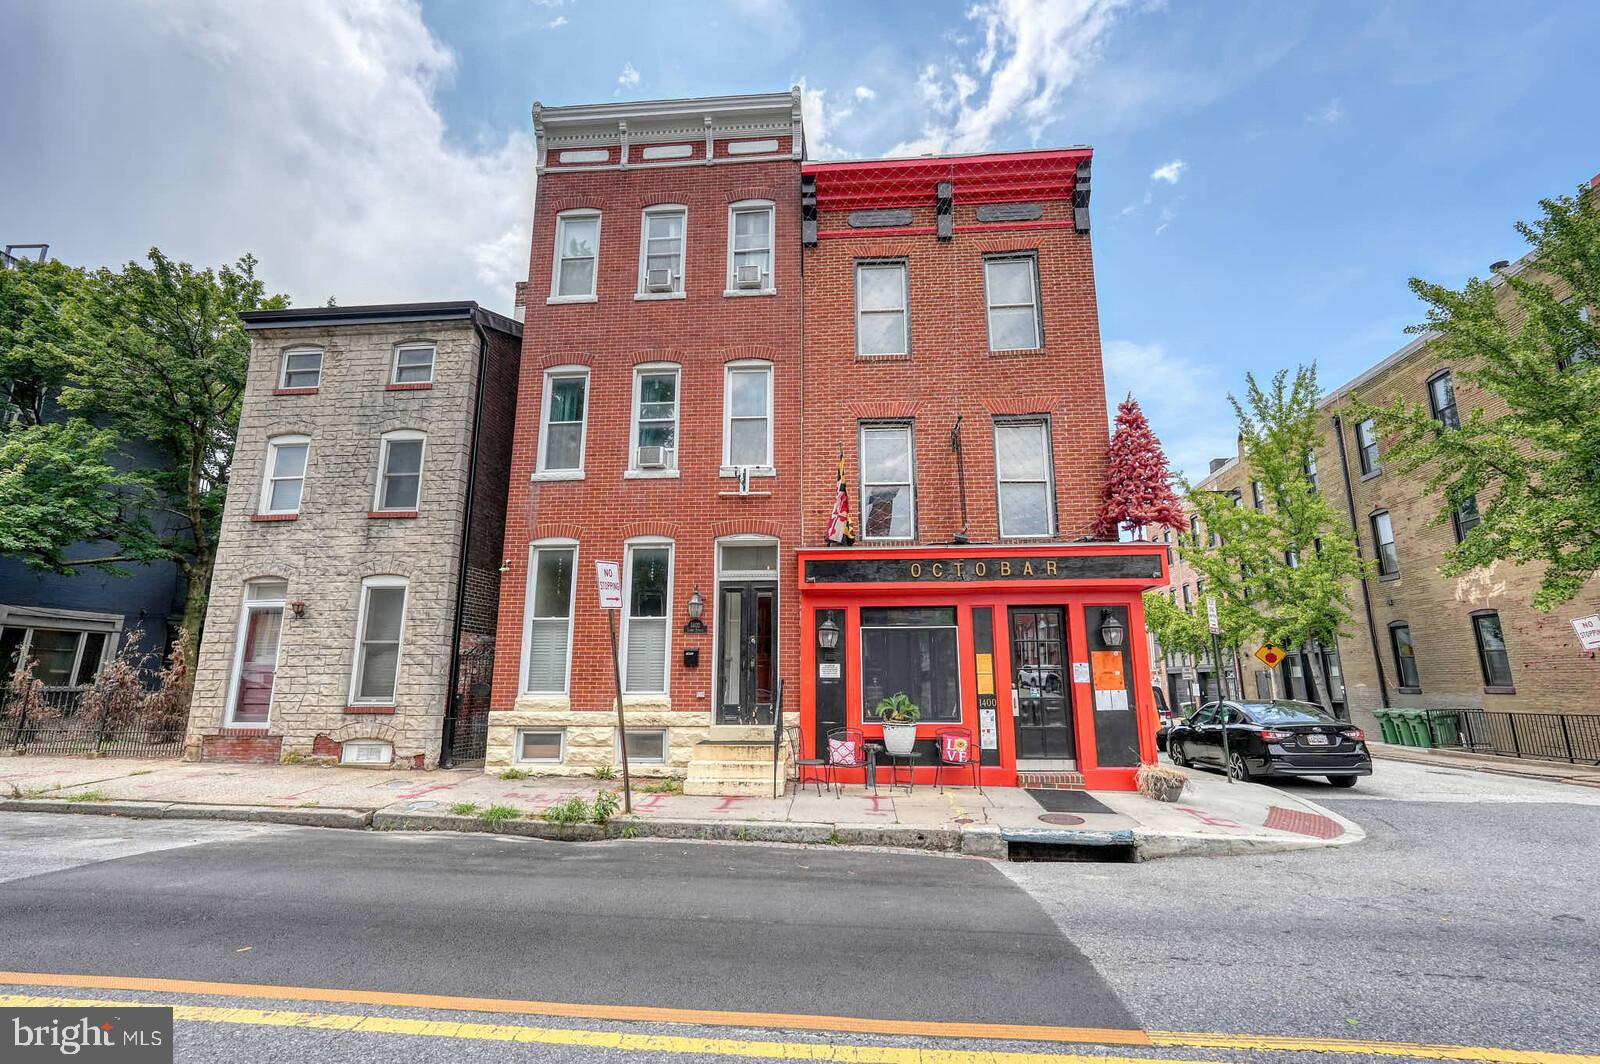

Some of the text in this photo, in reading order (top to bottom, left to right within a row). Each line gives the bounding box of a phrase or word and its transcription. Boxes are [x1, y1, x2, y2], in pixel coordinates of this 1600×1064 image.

[603, 568, 613, 578] NO
[910, 560, 1058, 578] OCTOBAR
[599, 581, 621, 591] STOPPING
[1582, 620, 1594, 629] NO
[979, 698, 998, 707] 1400
